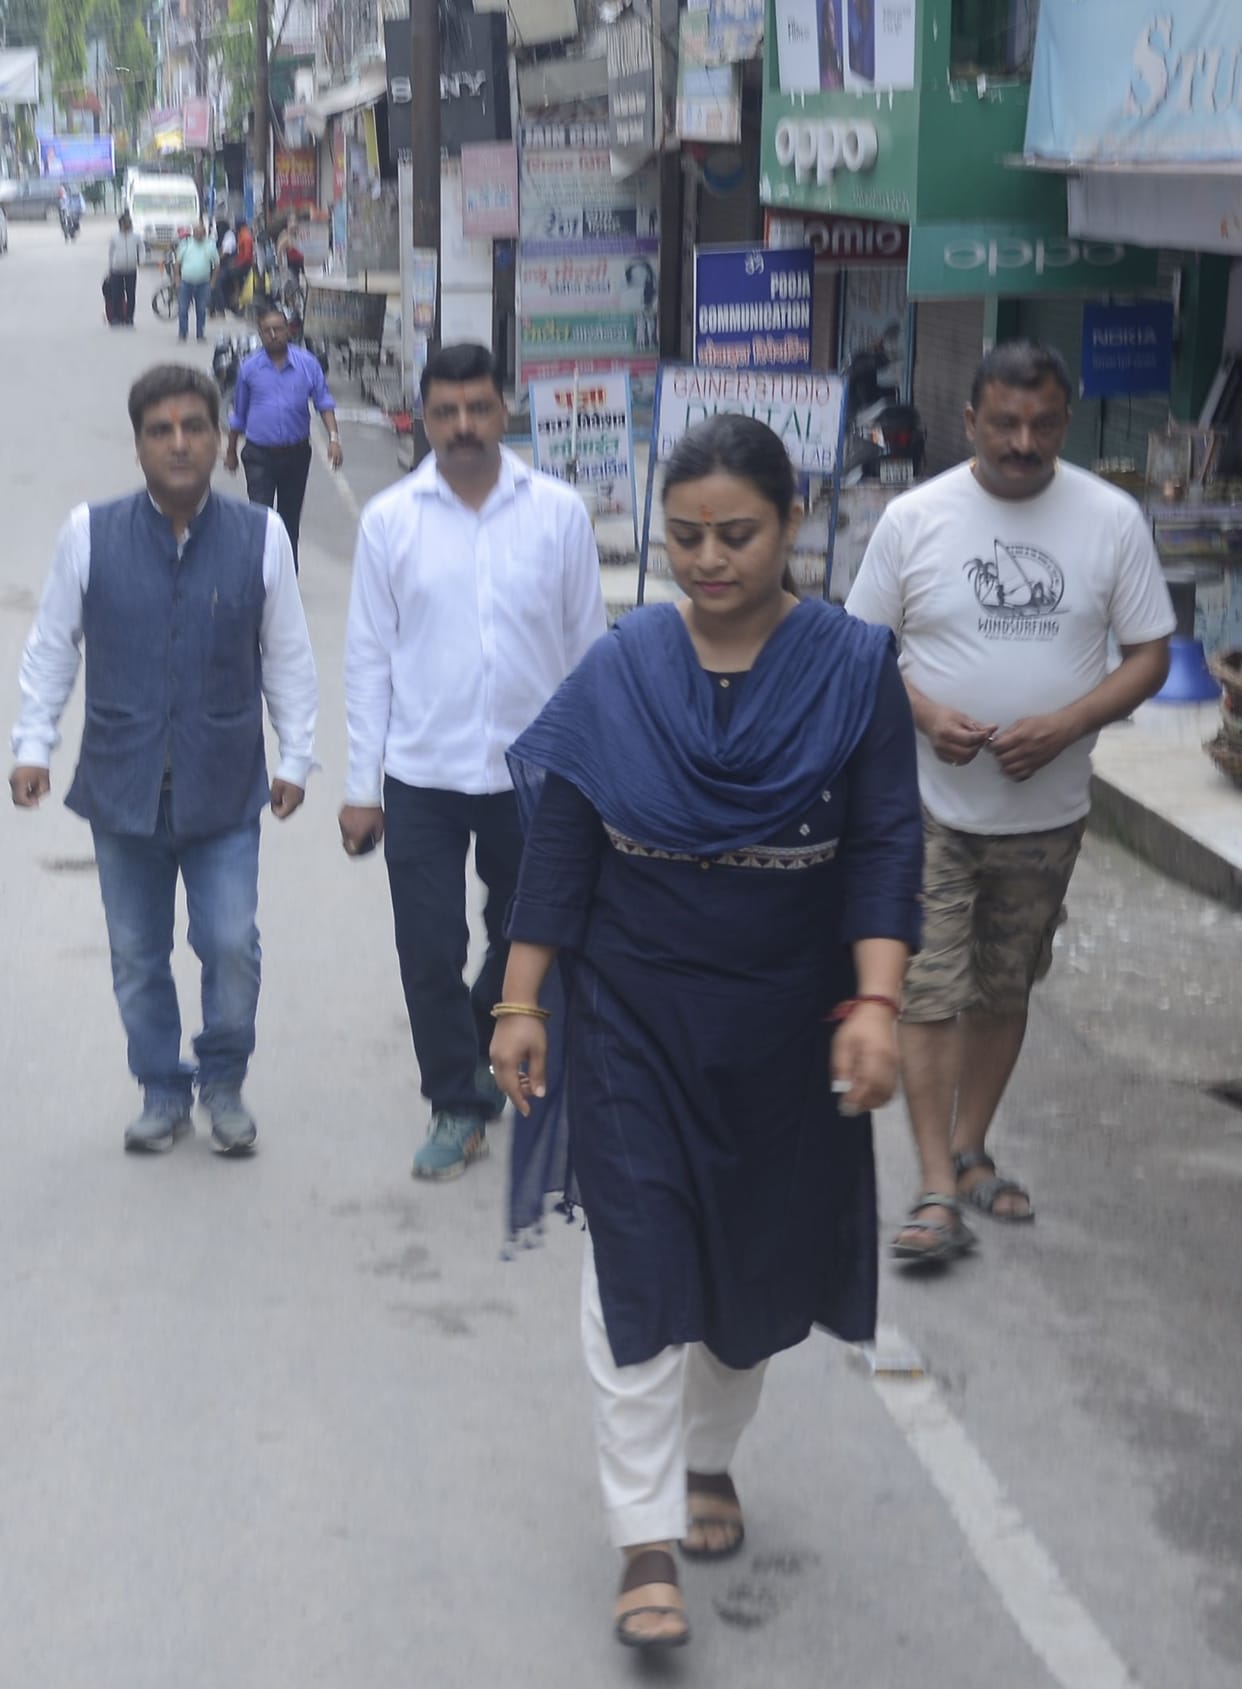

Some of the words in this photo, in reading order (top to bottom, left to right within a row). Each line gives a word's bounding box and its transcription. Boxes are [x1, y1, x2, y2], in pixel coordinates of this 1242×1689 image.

[391, 70, 486, 103] SNY
[775, 117, 877, 186] oppo
[944, 238, 1126, 276] oppo
[771, 269, 811, 300] POOJA
[699, 301, 810, 334] COMMUNICATION
[673, 369, 750, 401] GAINER
[754, 373, 831, 407] STUDIO
